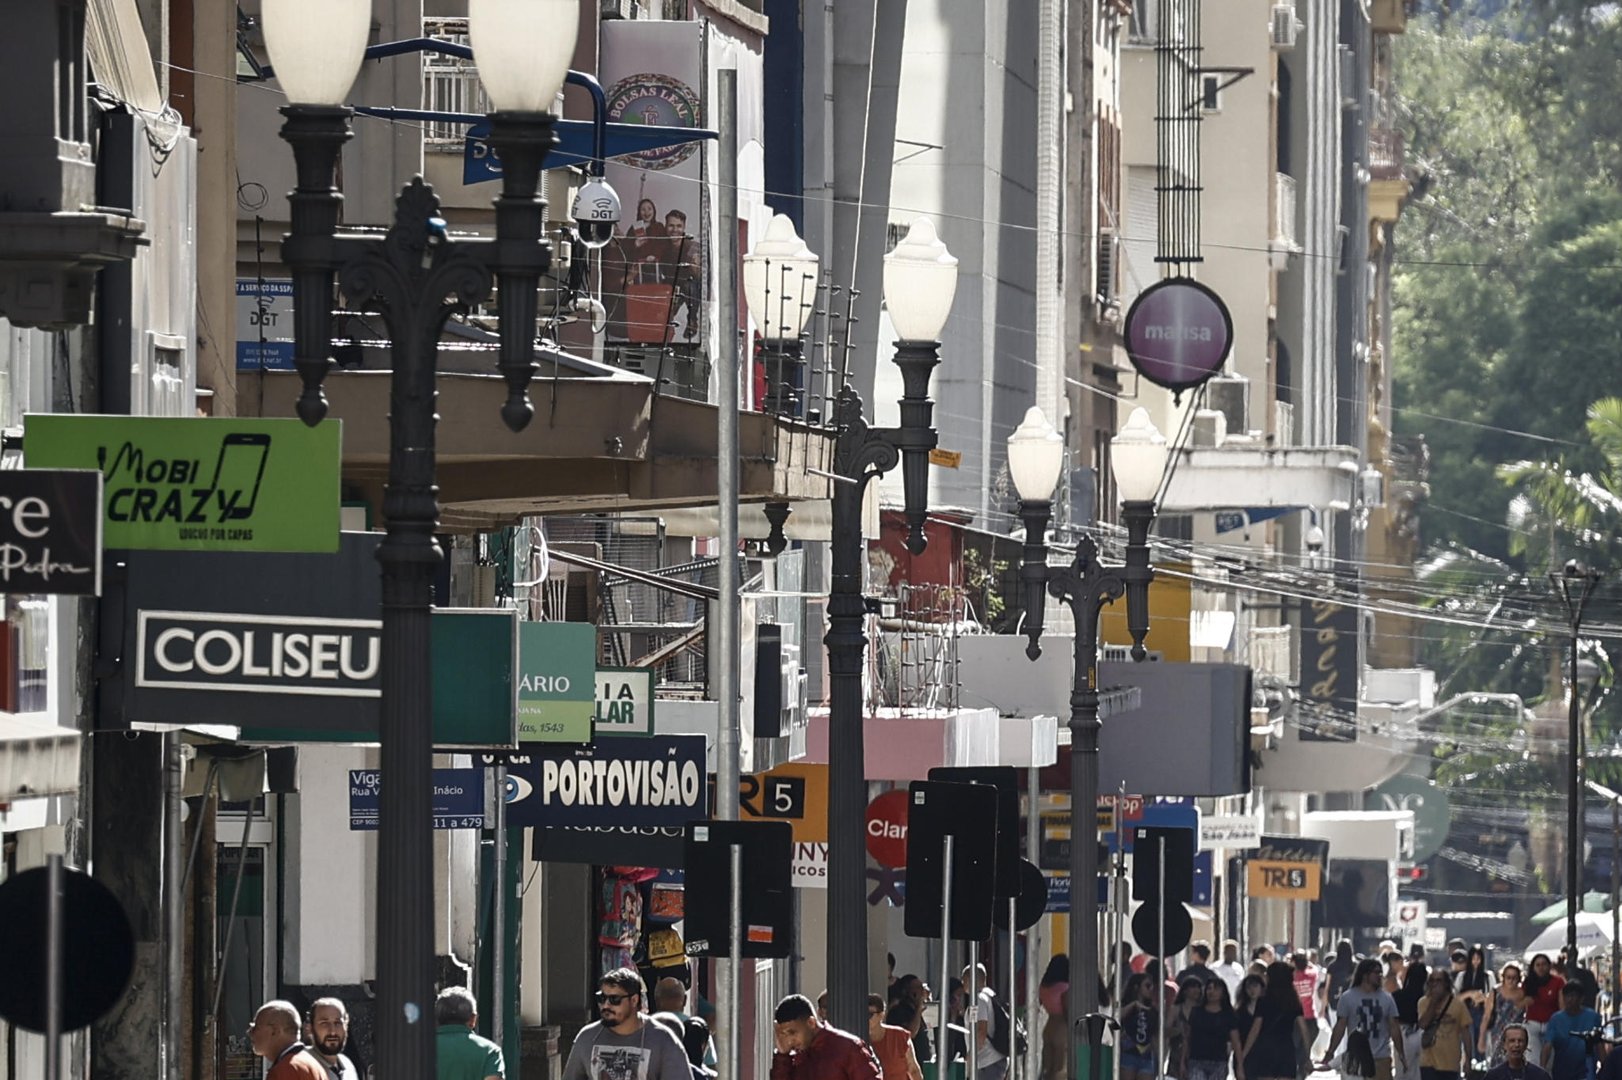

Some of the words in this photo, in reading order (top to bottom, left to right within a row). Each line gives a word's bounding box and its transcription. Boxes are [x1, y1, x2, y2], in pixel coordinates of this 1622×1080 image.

[610, 87, 657, 119] BOLSAS
[659, 88, 689, 119] LEAL
[591, 209, 614, 219] DGT
[246, 283, 270, 292] SERVÇO
[1144, 325, 1212, 342] maisa
[104, 441, 200, 484] MOBI
[107, 488, 243, 523] CRAZY
[153, 626, 381, 681] COLISEU
[520, 673, 571, 692] ÁRIO
[540, 723, 565, 733] 1543
[542, 747, 700, 807] PORTOVISÃO
[351, 787, 370, 797] Rua
[433, 785, 464, 796] Inácio
[450, 820, 458, 828] a
[461, 817, 483, 828] 479
